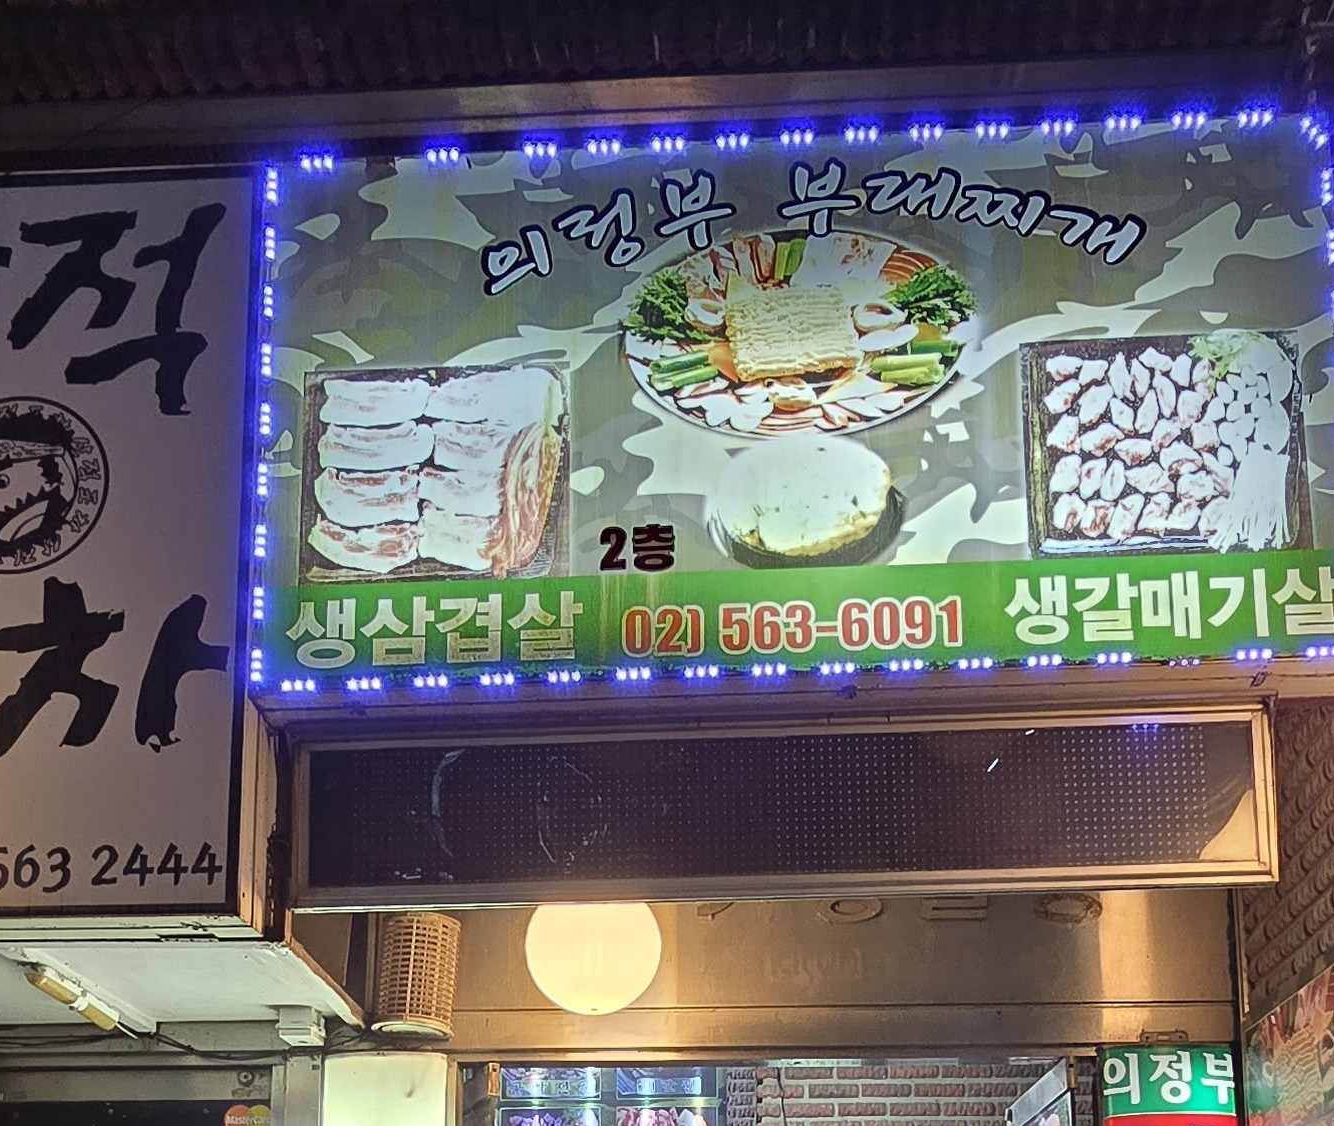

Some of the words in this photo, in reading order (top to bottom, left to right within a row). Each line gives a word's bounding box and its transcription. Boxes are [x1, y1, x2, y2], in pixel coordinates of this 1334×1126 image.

[483, 168, 735, 296] 의정부
[778, 157, 1147, 266] 부대찌개
[599, 522, 677, 574] 2층
[286, 588, 584, 669] 생삼겹살
[621, 604, 705, 659] 02)
[718, 595, 965, 652] 563-6091
[91, 842, 223, 887] 2444
[1103, 1051, 1235, 1105] 의정부
